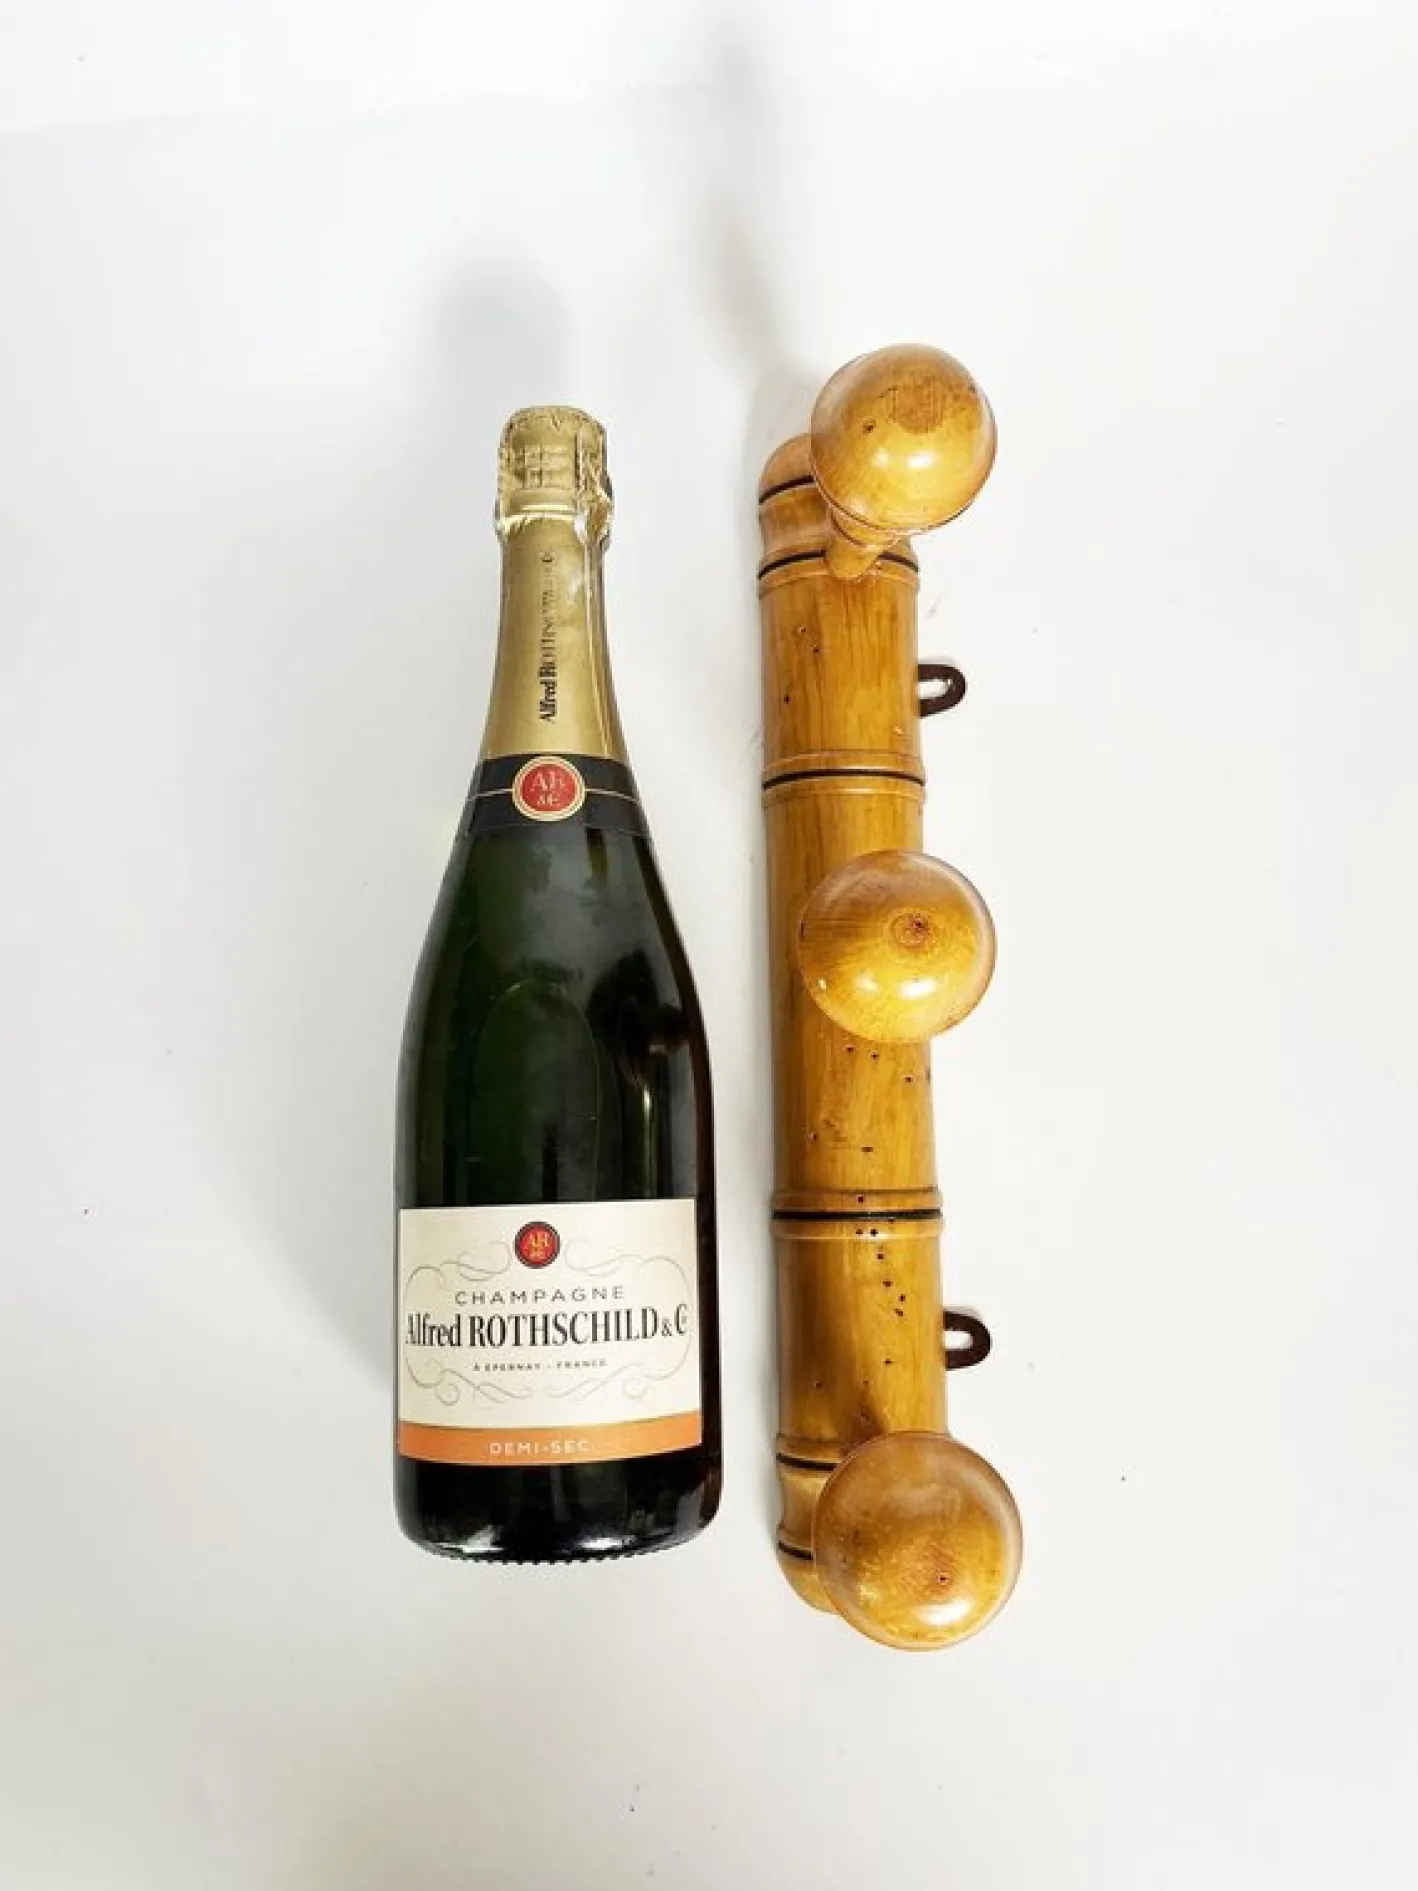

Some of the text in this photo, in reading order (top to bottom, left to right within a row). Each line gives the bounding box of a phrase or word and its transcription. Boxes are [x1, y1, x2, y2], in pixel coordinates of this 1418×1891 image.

[455, 1286, 625, 1306] CHAMPAGNE
[405, 1311, 461, 1347] Alfred
[489, 1440, 590, 1454] DEMI-SEC
